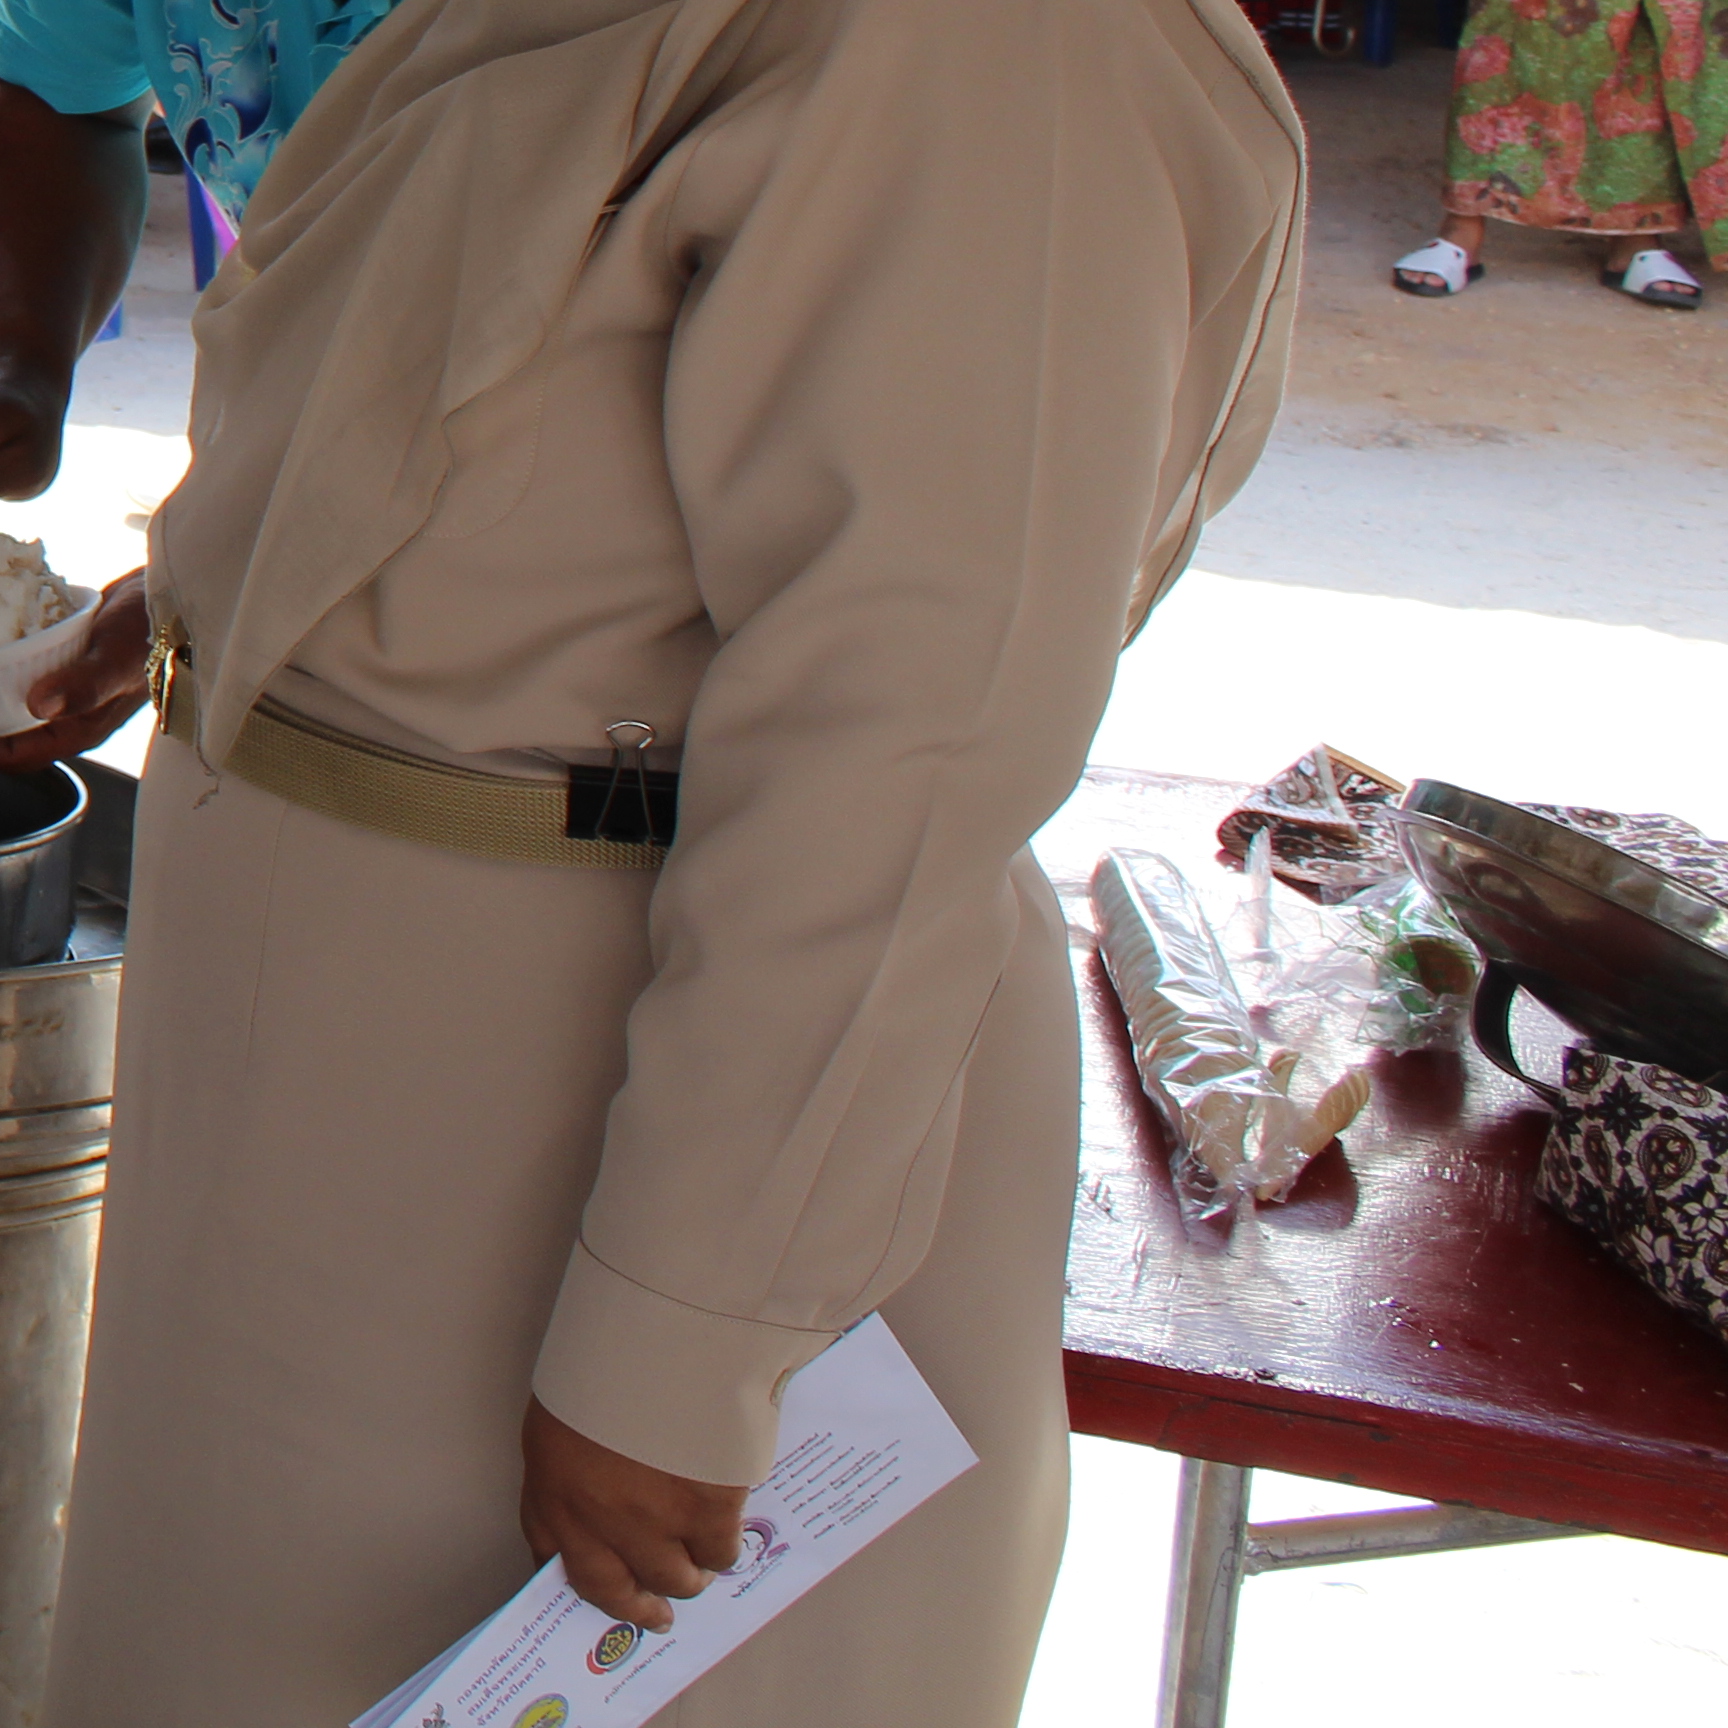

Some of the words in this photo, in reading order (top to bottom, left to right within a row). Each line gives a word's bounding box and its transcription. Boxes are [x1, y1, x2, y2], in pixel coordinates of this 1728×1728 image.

[477, 1656, 546, 1726] จังหวัดปัตตานี
